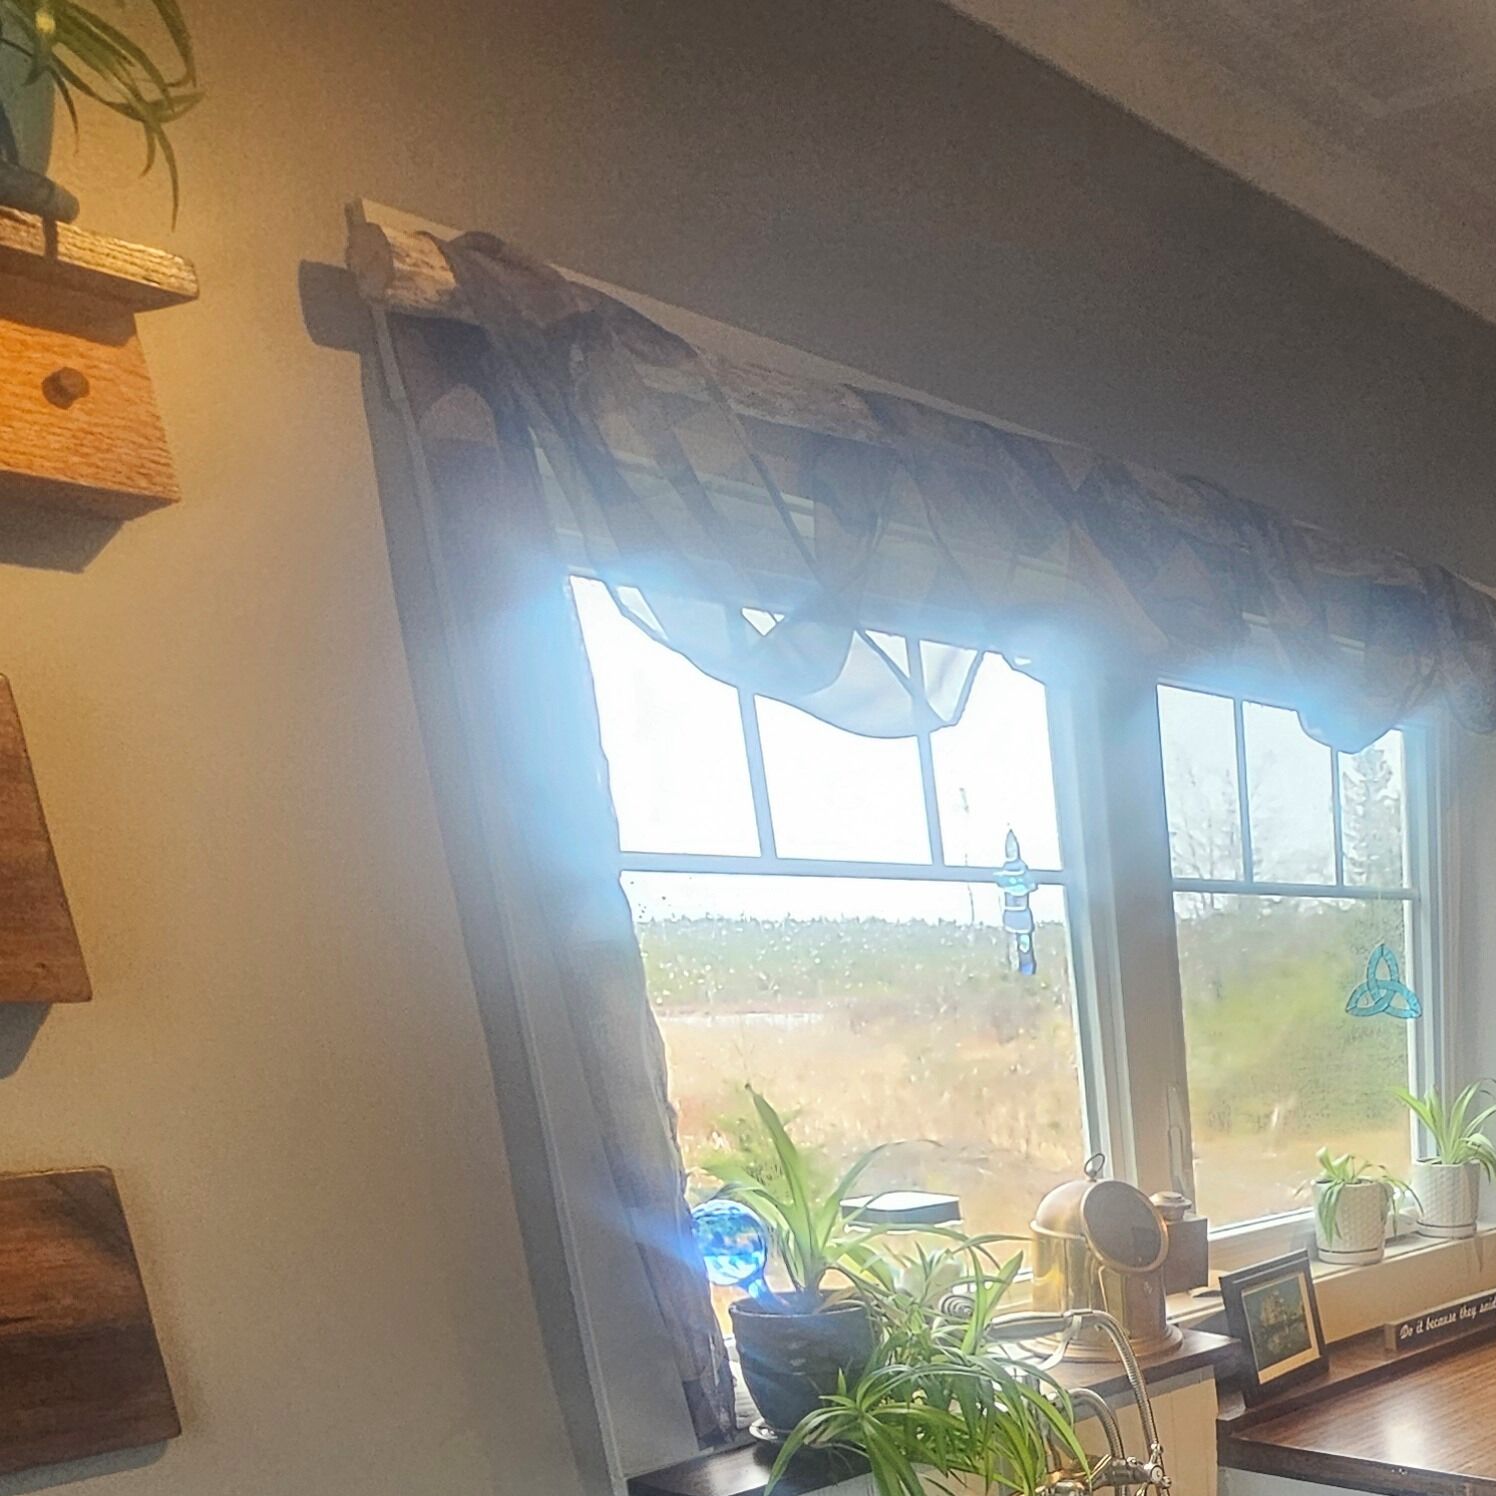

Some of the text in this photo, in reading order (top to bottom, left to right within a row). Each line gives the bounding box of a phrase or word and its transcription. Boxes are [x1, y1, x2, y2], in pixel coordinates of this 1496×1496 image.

[1400, 1324, 1413, 1340] Do
[1416, 1319, 1424, 1334] it
[1426, 1312, 1457, 1331] because
[1459, 1304, 1477, 1319] they
[1479, 1297, 1496, 1313] said
